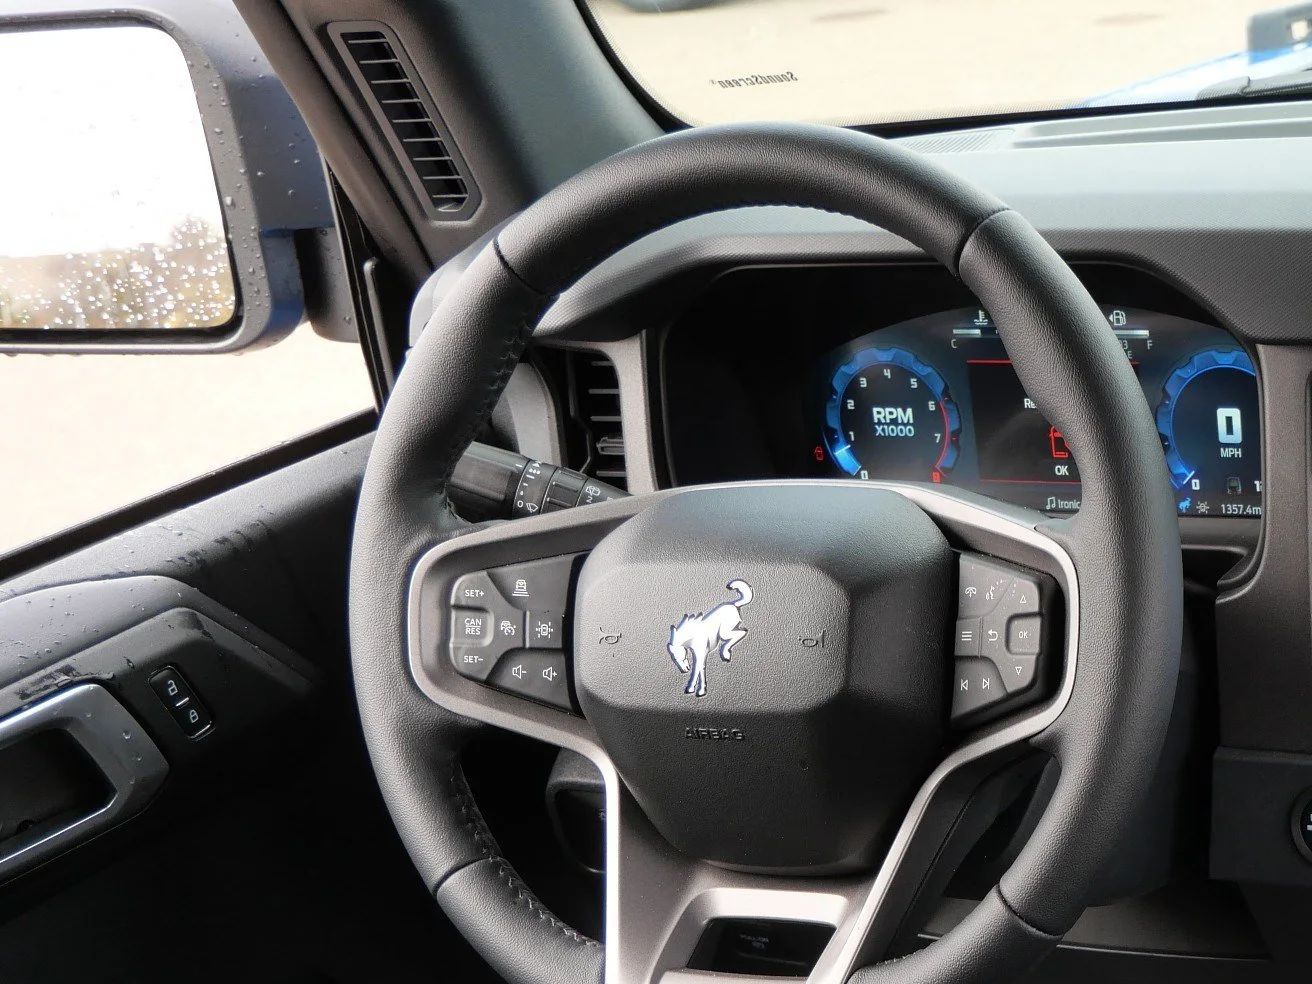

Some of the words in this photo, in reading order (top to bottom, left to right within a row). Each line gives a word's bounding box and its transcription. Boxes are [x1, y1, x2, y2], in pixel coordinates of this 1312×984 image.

[1146, 339, 1153, 351] F
[883, 368, 892, 379] 4
[859, 377, 868, 388] 3
[910, 378, 918, 389] 5
[846, 400, 855, 410] 2
[928, 400, 936, 411] 6
[872, 407, 914, 424] RPM
[875, 425, 915, 437] X1000
[1216, 407, 1243, 444] 0
[848, 431, 855, 442] 1
[934, 433, 941, 443] 7
[1220, 447, 1242, 459] MPH
[1055, 465, 1069, 476] OK
[464, 618, 482, 627] CAN
[465, 627, 481, 636] RES
[1018, 630, 1029, 640] OK
